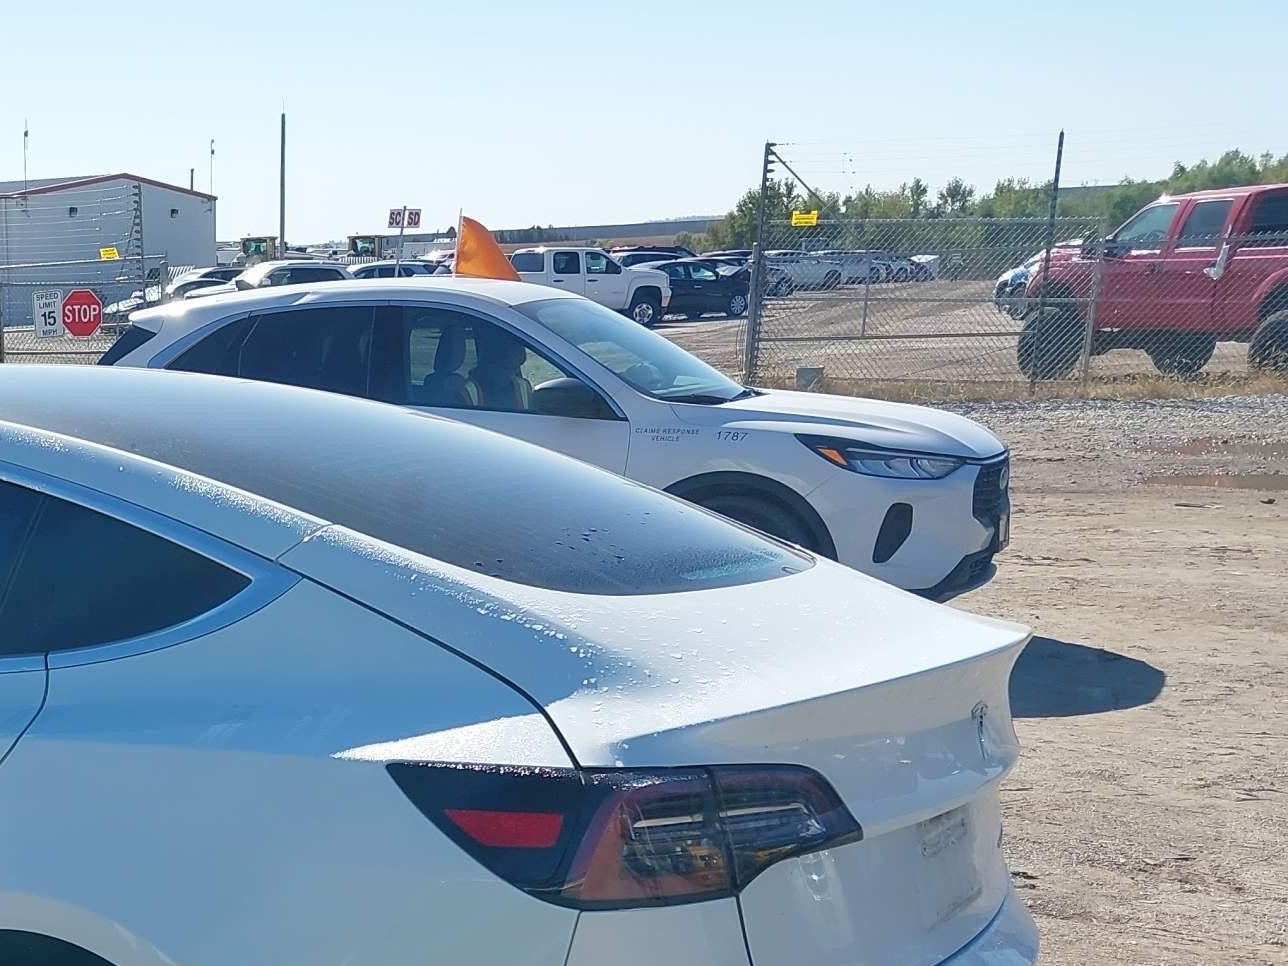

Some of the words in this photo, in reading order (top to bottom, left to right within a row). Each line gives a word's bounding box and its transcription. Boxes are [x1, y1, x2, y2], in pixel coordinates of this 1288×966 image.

[389, 211, 402, 226] SC
[407, 211, 420, 226] SD
[36, 292, 58, 301] SPEED
[39, 301, 57, 309] LIMIT
[41, 310, 57, 327] 15
[64, 304, 99, 323] STOP
[42, 328, 58, 336] MPH
[717, 430, 748, 441] 1787
